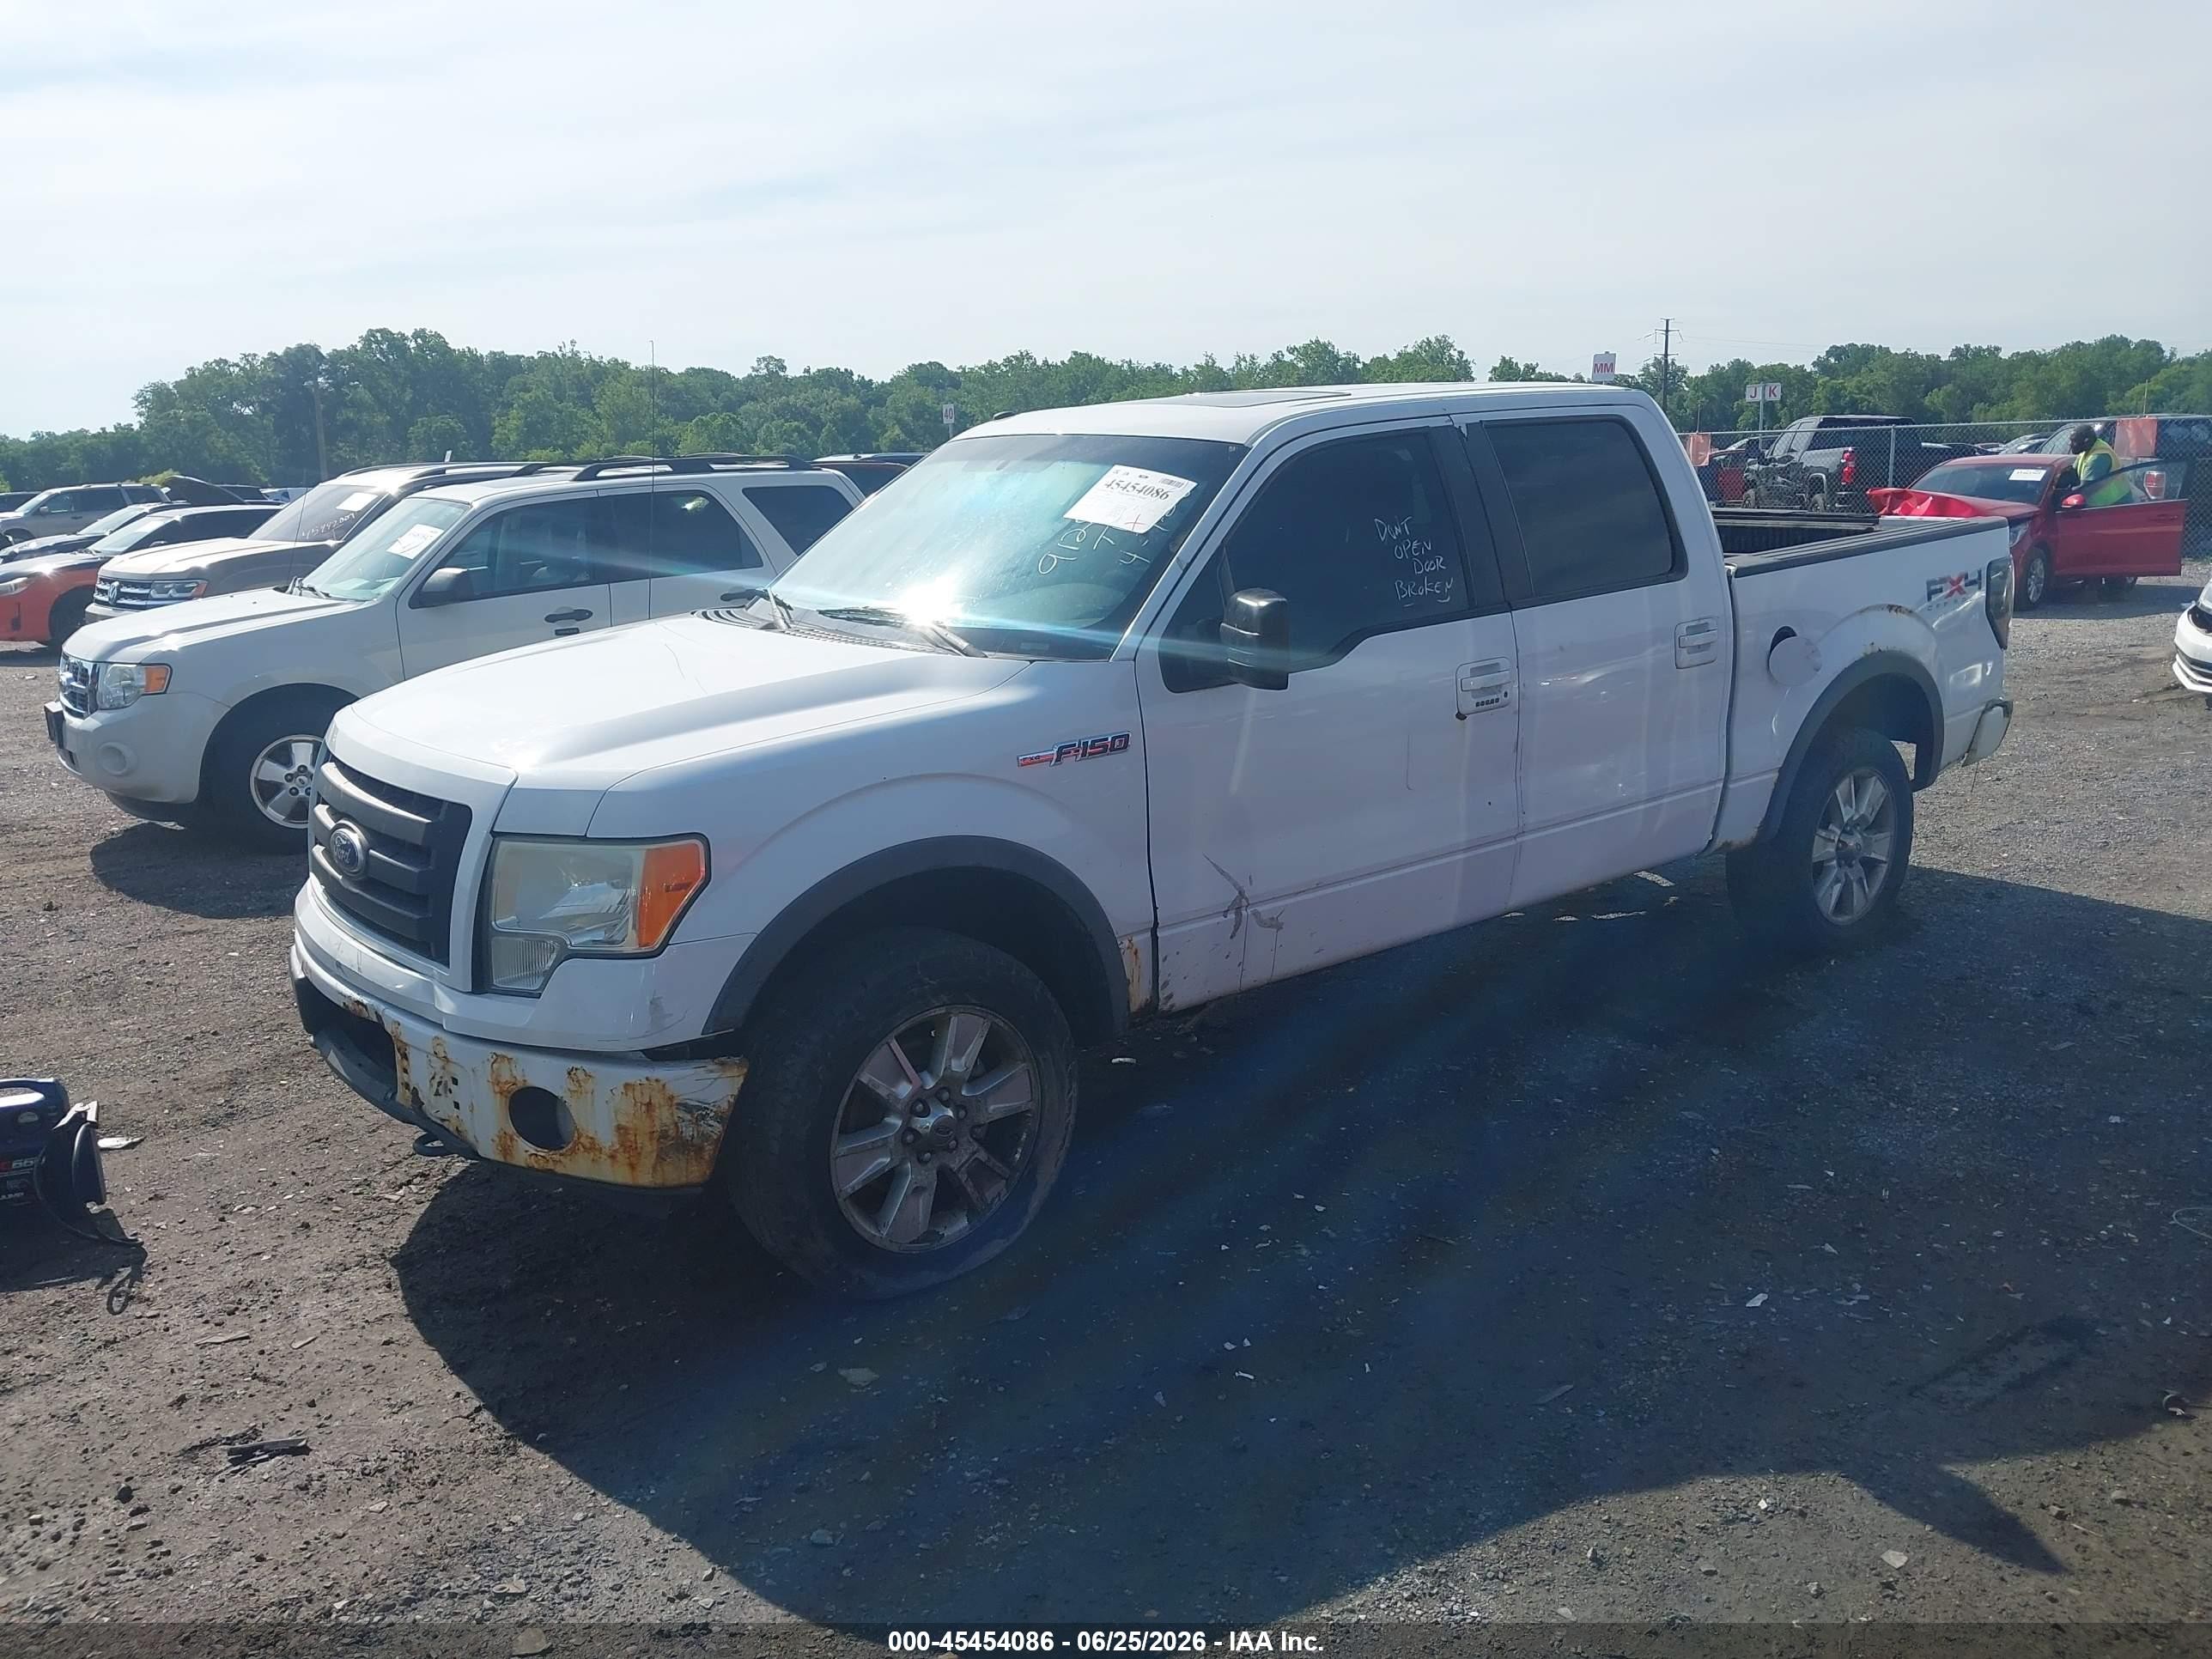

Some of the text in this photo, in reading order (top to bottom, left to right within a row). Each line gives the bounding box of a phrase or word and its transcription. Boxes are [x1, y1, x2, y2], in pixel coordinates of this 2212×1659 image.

[1593, 362, 1613, 374] MM
[1749, 387, 1758, 399] J
[1767, 386, 1778, 398] K
[944, 408, 954, 420] 40
[1103, 478, 1170, 501] 45454086
[1394, 538, 1431, 559] OPEN
[1413, 556, 1447, 574] DOOR
[1926, 568, 1983, 601] FX4
